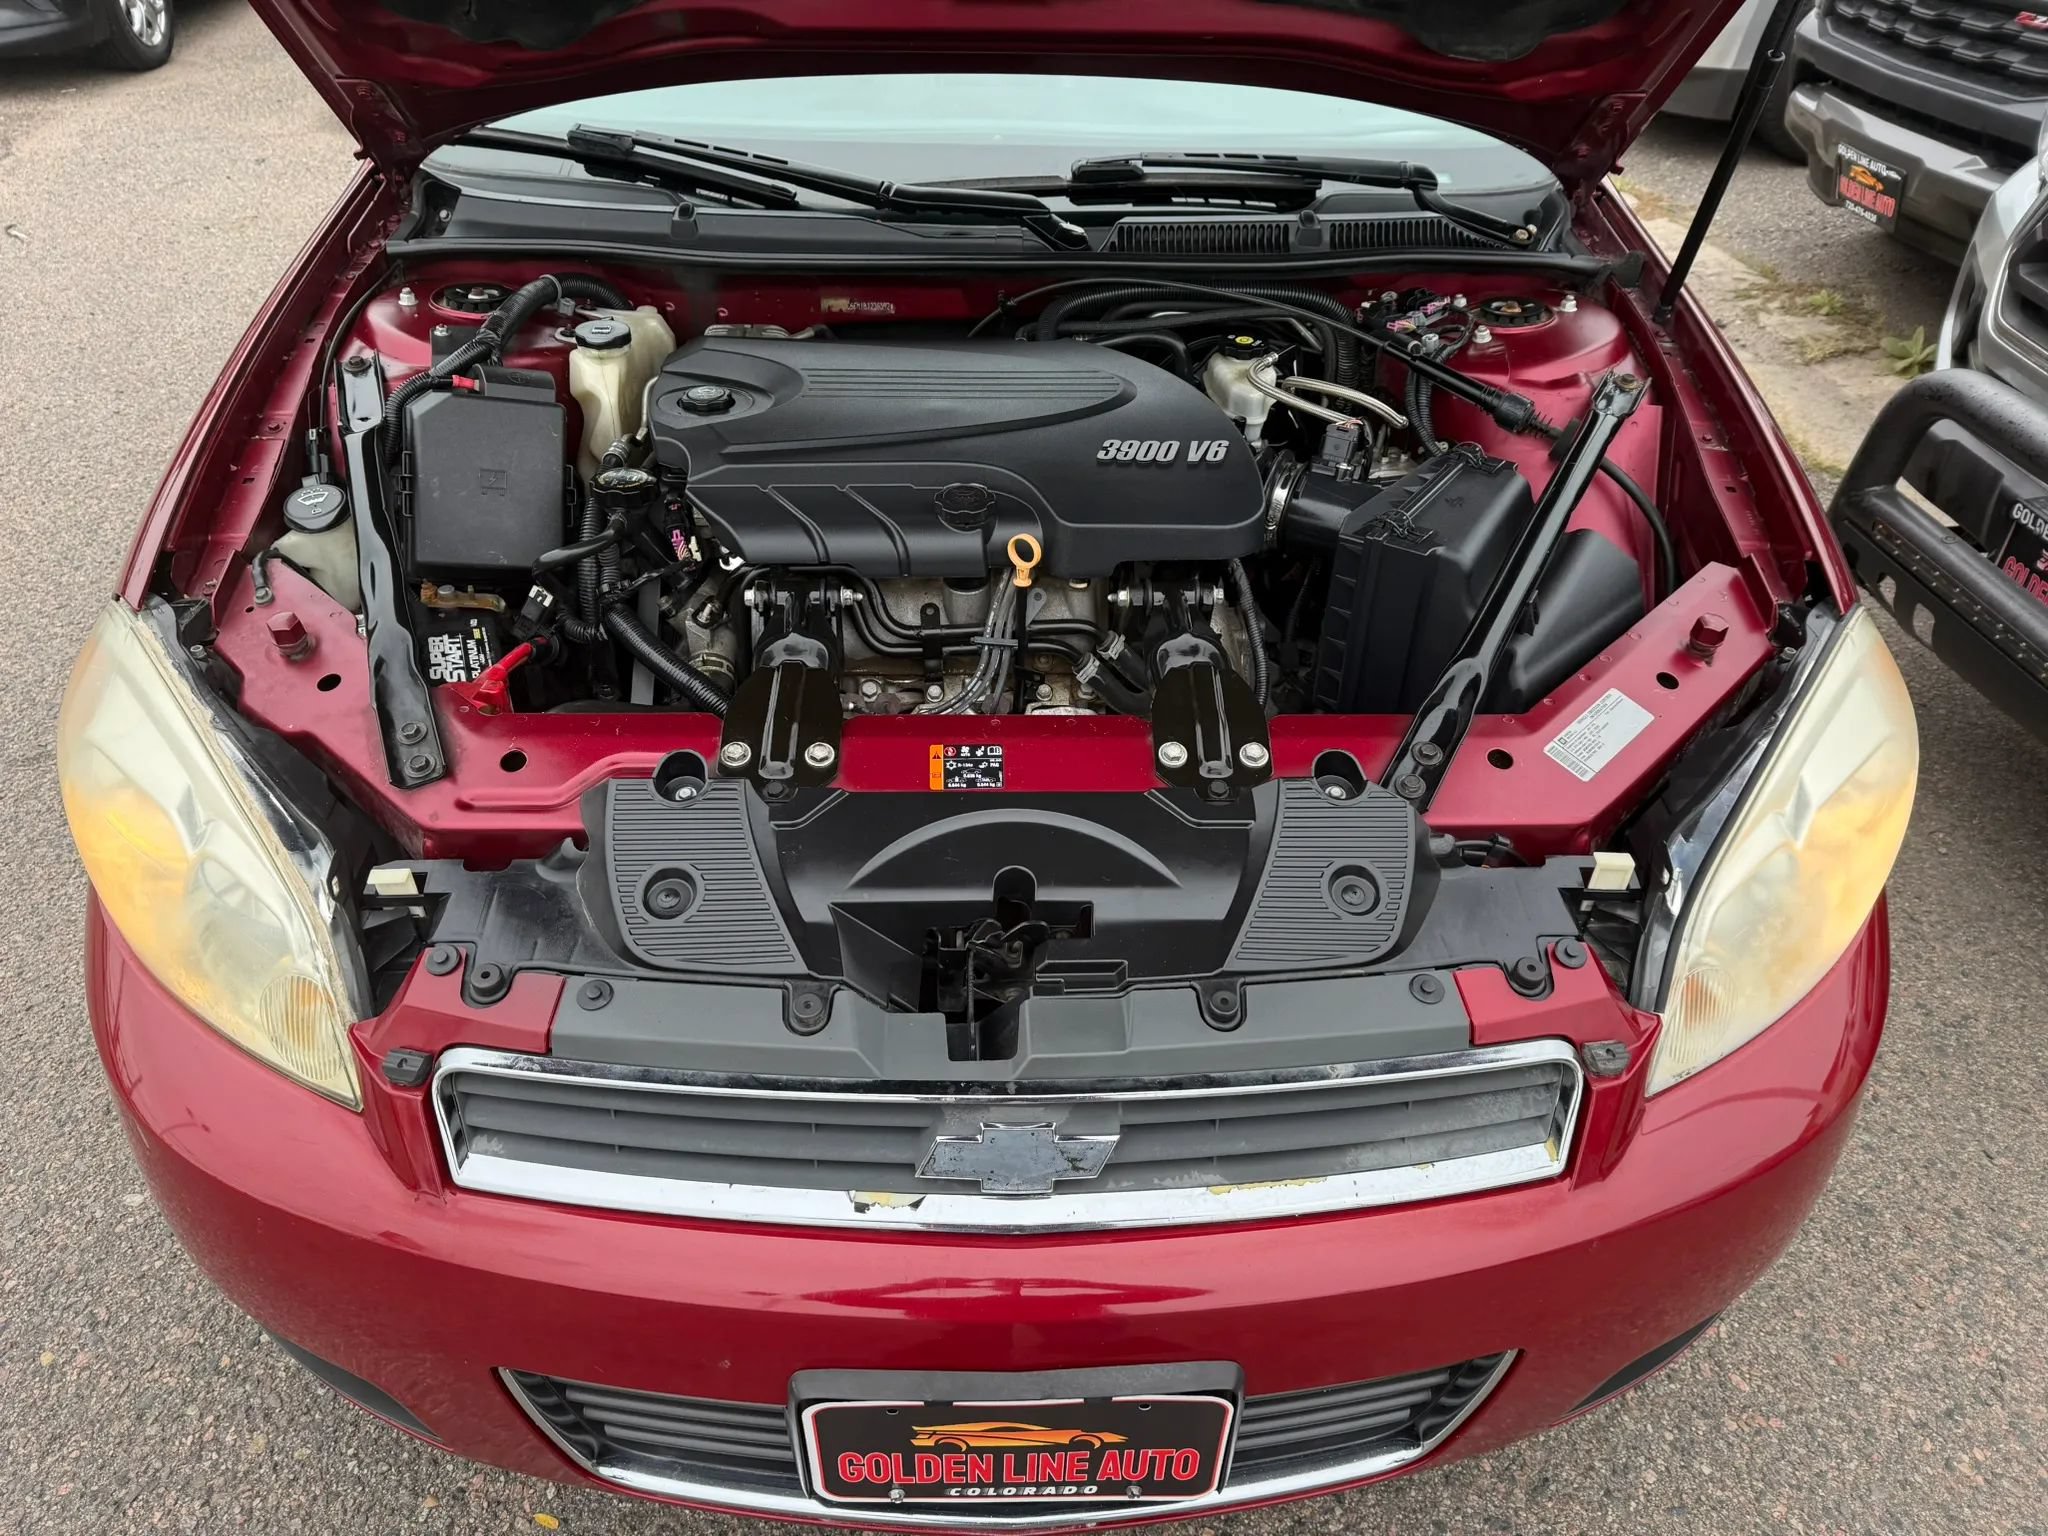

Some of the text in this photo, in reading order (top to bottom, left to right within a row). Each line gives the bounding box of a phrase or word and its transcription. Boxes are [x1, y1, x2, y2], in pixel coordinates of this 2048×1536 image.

[1857, 154, 1870, 169] LINE
[1870, 160, 1887, 176] AUTO
[1096, 439, 1230, 462] 3900 V6
[427, 636, 446, 680] SUPER
[442, 633, 467, 683] START
[466, 639, 482, 679] PLATINUM
[837, 1447, 1201, 1485] GOLDEN LINE AUTO
[949, 1484, 1099, 1497] COLORADO
